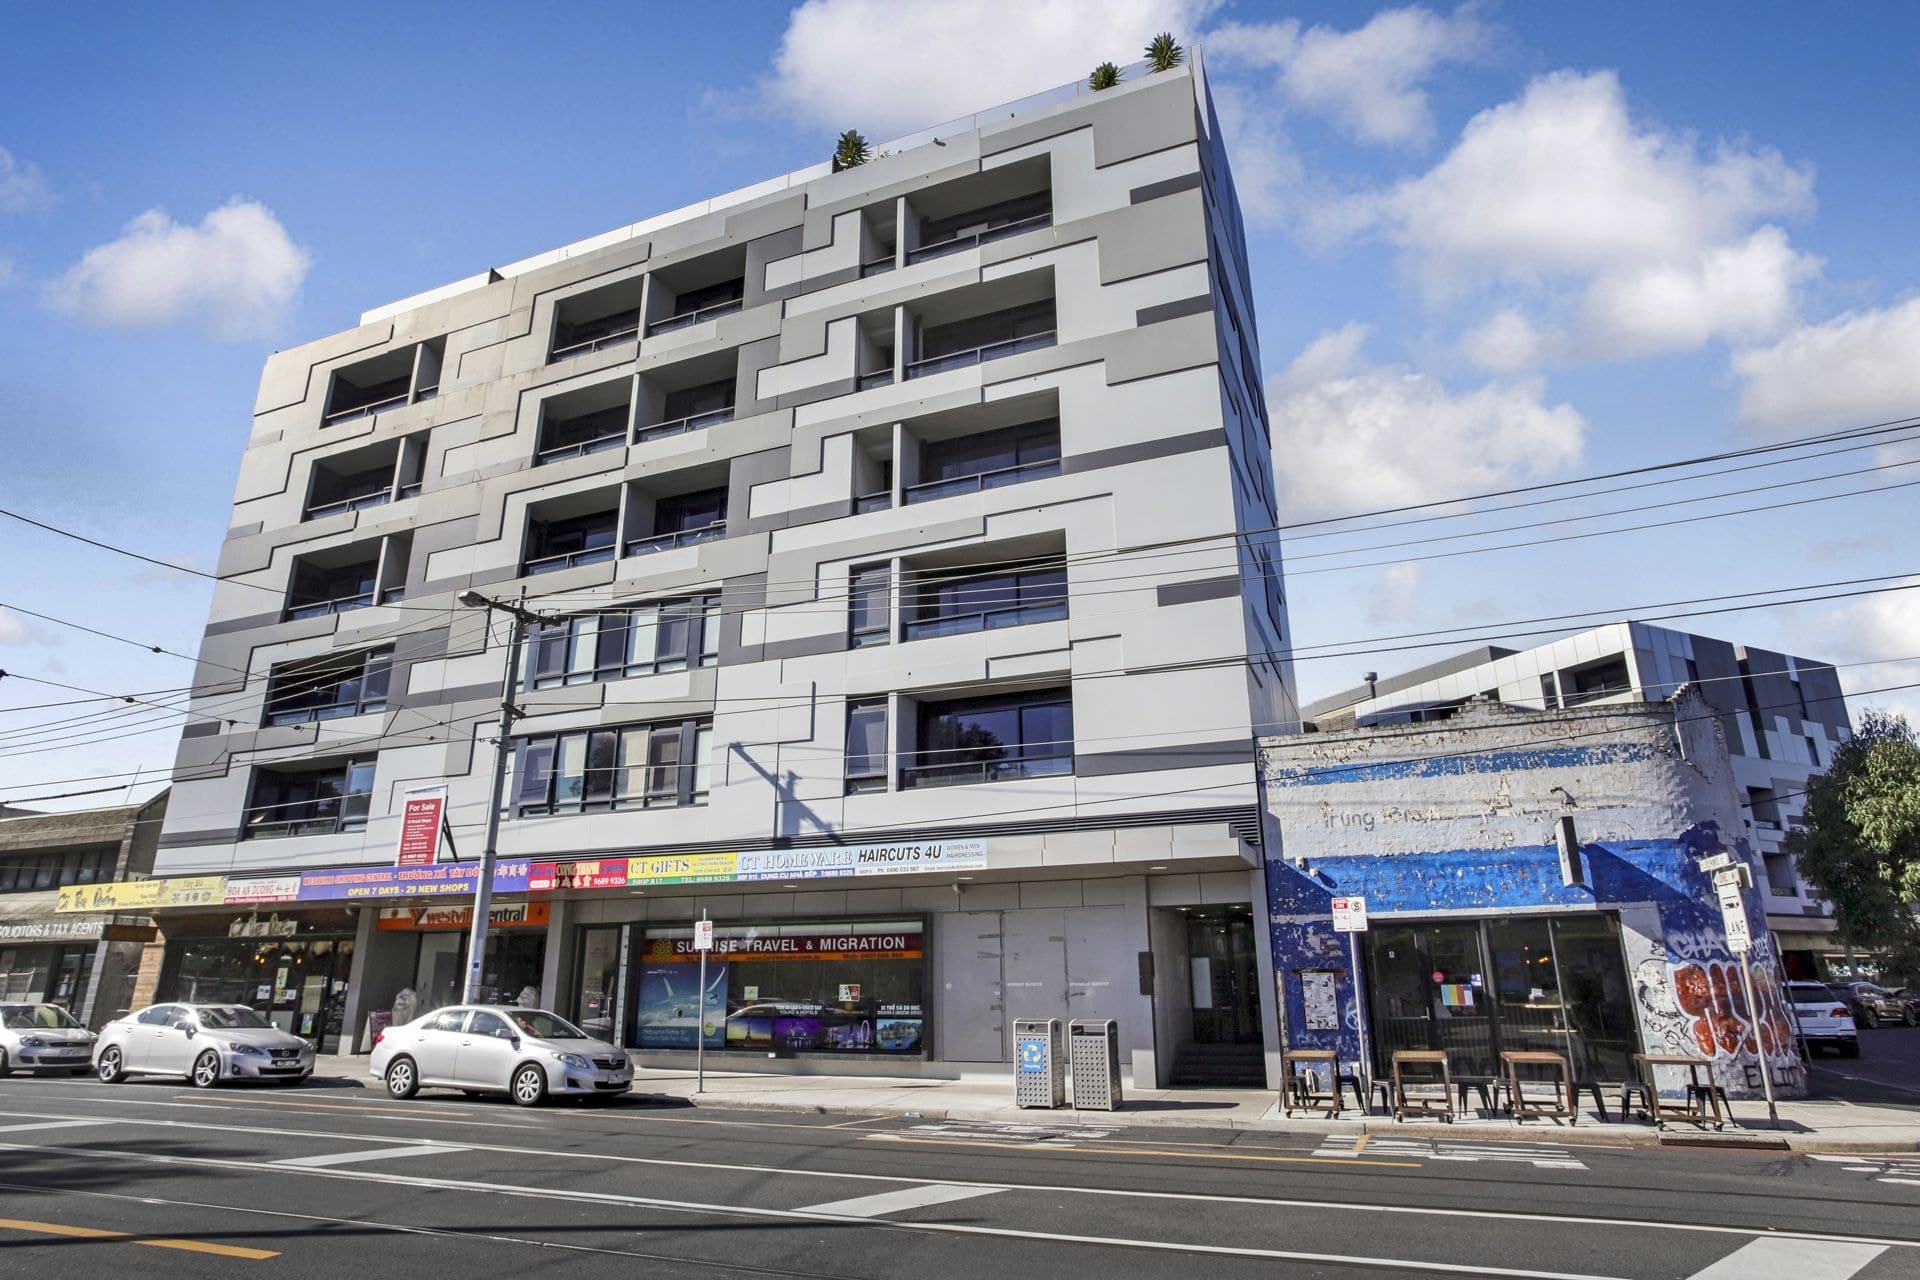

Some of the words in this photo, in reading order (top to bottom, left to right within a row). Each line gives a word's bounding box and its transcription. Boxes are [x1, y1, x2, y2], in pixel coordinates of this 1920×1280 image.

[408, 804, 421, 812] For
[421, 803, 436, 811] Sale
[740, 855, 760, 871] CT
[763, 849, 853, 869] HOMEWARE
[858, 846, 920, 863] HAIRCUTS
[924, 845, 942, 859] 4U
[630, 861, 648, 874] CT
[651, 859, 690, 874] GIFTS
[347, 887, 370, 897] OPEN
[372, 887, 378, 895] 7
[378, 886, 400, 896] DAYS
[405, 885, 417, 894] 29
[417, 884, 439, 893] NEW
[440, 883, 469, 893] SHOPS
[426, 907, 474, 924] westvill
[489, 905, 525, 922] entral
[52, 923, 70, 937] TAX
[70, 921, 104, 936] AGENTS
[676, 940, 738, 953] SUISE
[744, 939, 799, 952] TRAVEL
[805, 940, 813, 950] &
[820, 936, 905, 951] MIGRATION
